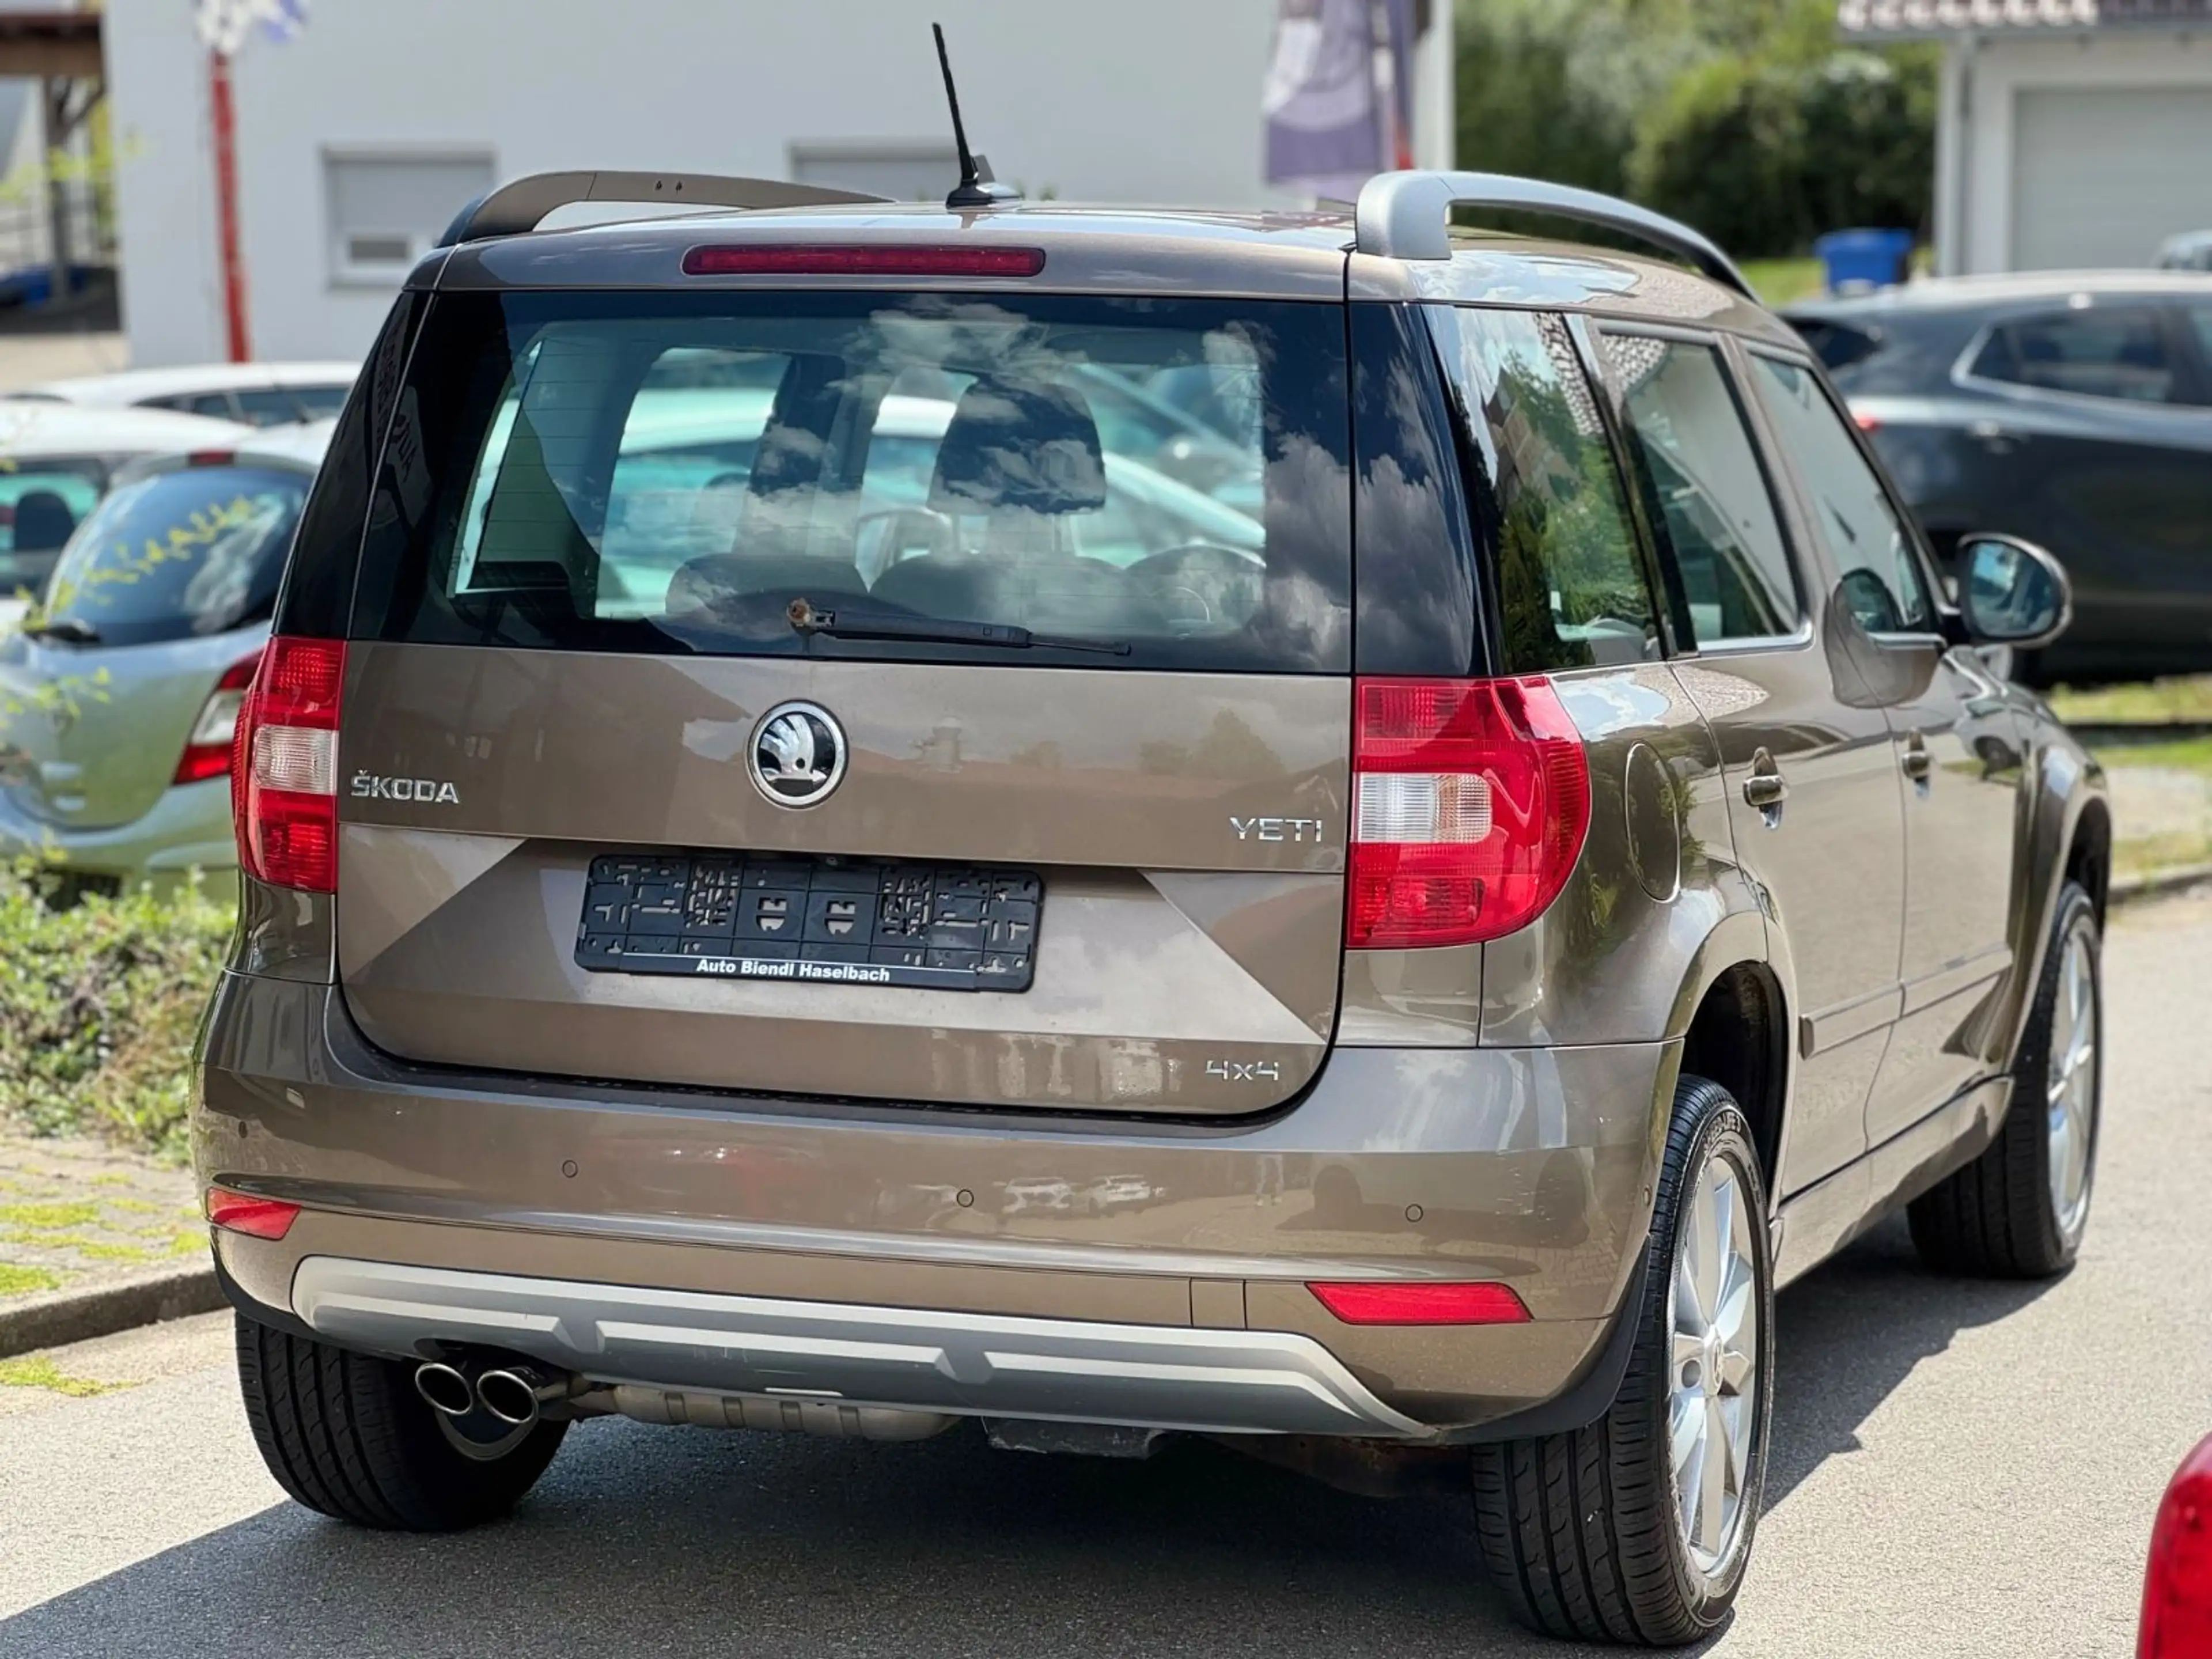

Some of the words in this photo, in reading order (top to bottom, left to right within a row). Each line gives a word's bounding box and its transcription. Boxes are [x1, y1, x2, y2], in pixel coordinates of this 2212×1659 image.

[350, 770, 459, 804] ŠKODA
[1229, 817, 1322, 842] YETI
[696, 959, 736, 974] Auto
[741, 960, 795, 976] Biendl
[799, 963, 890, 982] Haselbach
[1205, 1060, 1279, 1081] 4x4
